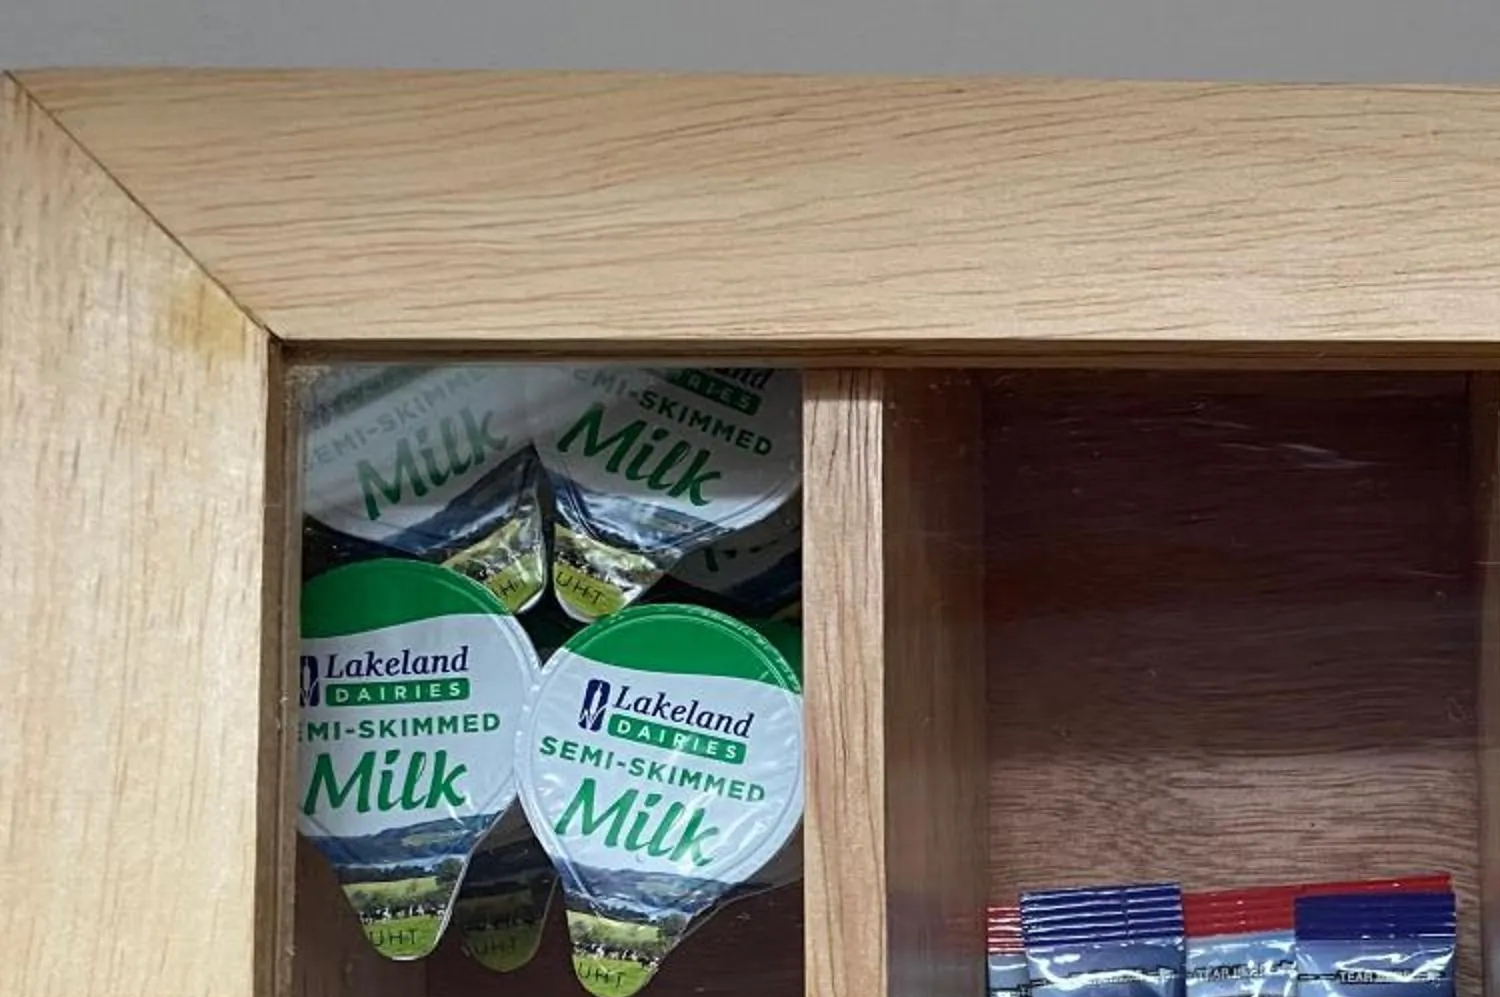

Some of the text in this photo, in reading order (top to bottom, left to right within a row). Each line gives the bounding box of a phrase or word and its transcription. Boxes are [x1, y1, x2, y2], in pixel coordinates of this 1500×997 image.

[356, 405, 507, 521] Milk
[557, 402, 721, 506] Milk
[556, 570, 603, 606] UHT
[325, 645, 470, 678] Lakeland
[335, 682, 462, 703] DAIRIES
[613, 686, 755, 738] Lakeland
[298, 713, 501, 742] MI-SKIMMED
[617, 720, 738, 760] DAIRIES
[303, 750, 468, 816] Milk
[539, 735, 766, 802] SEMI-SKIMMED
[554, 778, 720, 867] Milk
[369, 928, 417, 947] UHT
[578, 963, 625, 987] UHT
